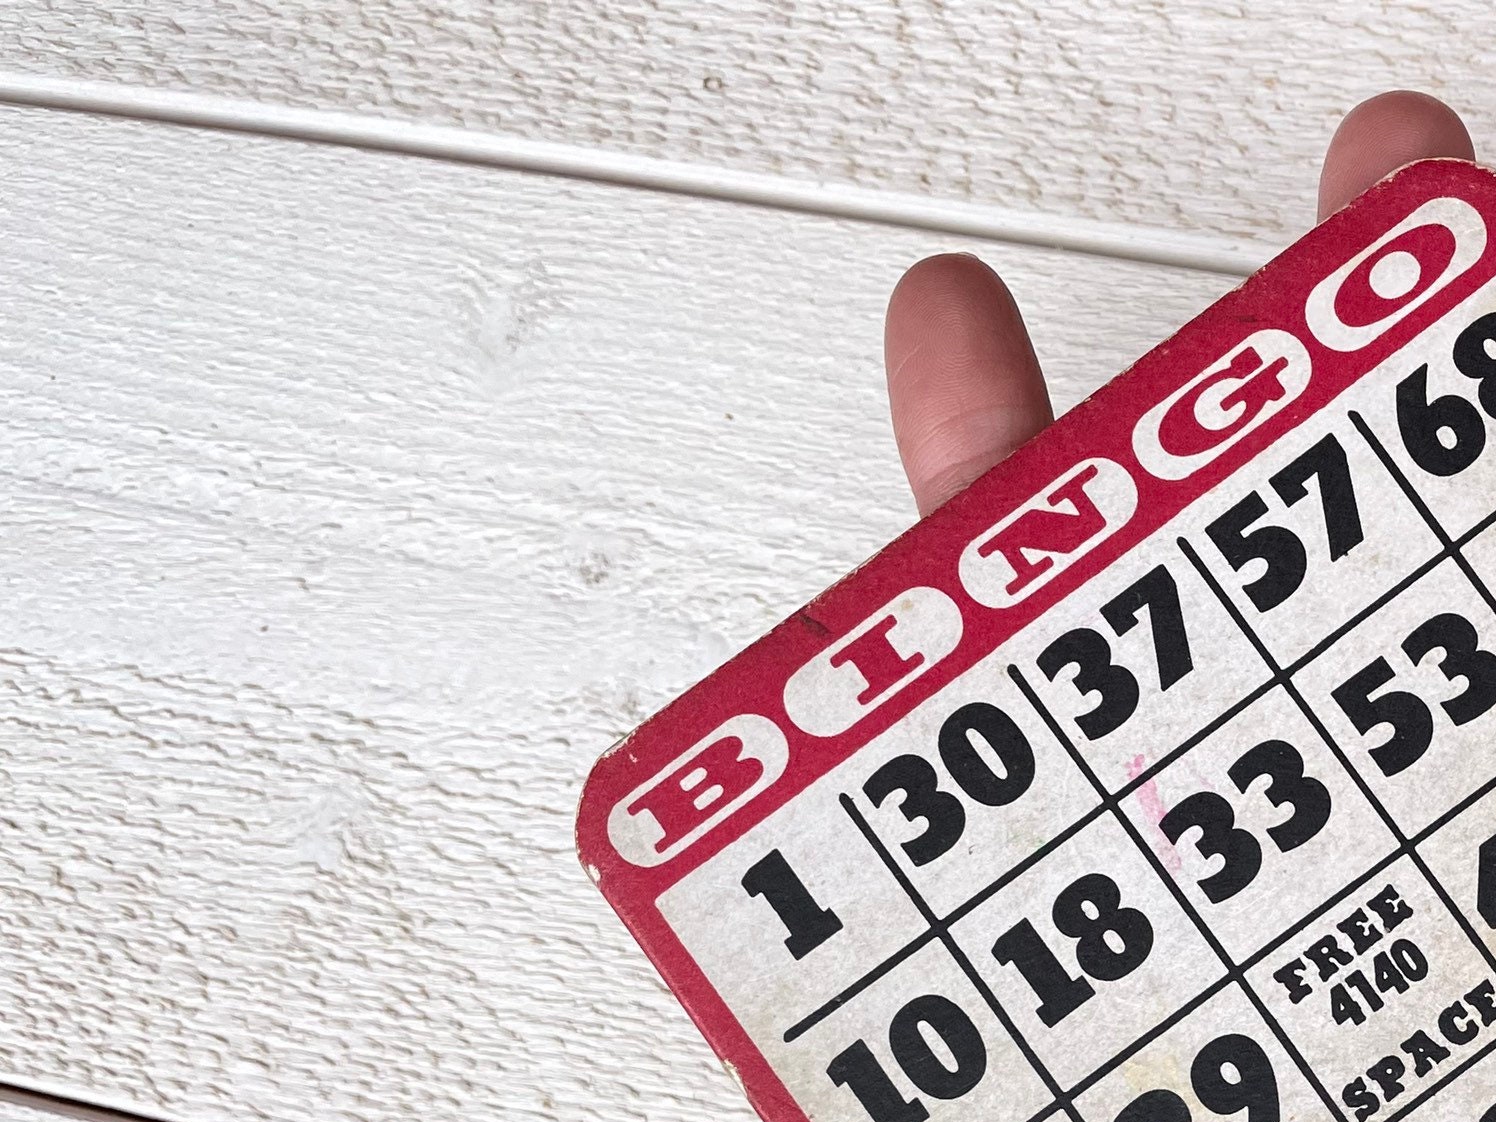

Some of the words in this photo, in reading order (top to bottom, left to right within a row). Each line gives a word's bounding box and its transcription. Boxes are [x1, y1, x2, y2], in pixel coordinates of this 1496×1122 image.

[626, 222, 1457, 854] BINGO
[742, 849, 843, 960] 1
[863, 703, 1035, 867] 30
[1037, 564, 1193, 740] 37
[1205, 433, 1363, 612] 57
[992, 874, 1153, 1028] 18
[1159, 740, 1331, 904] 33
[1273, 884, 1413, 1004] FREE
[1331, 939, 1428, 1025] 4140
